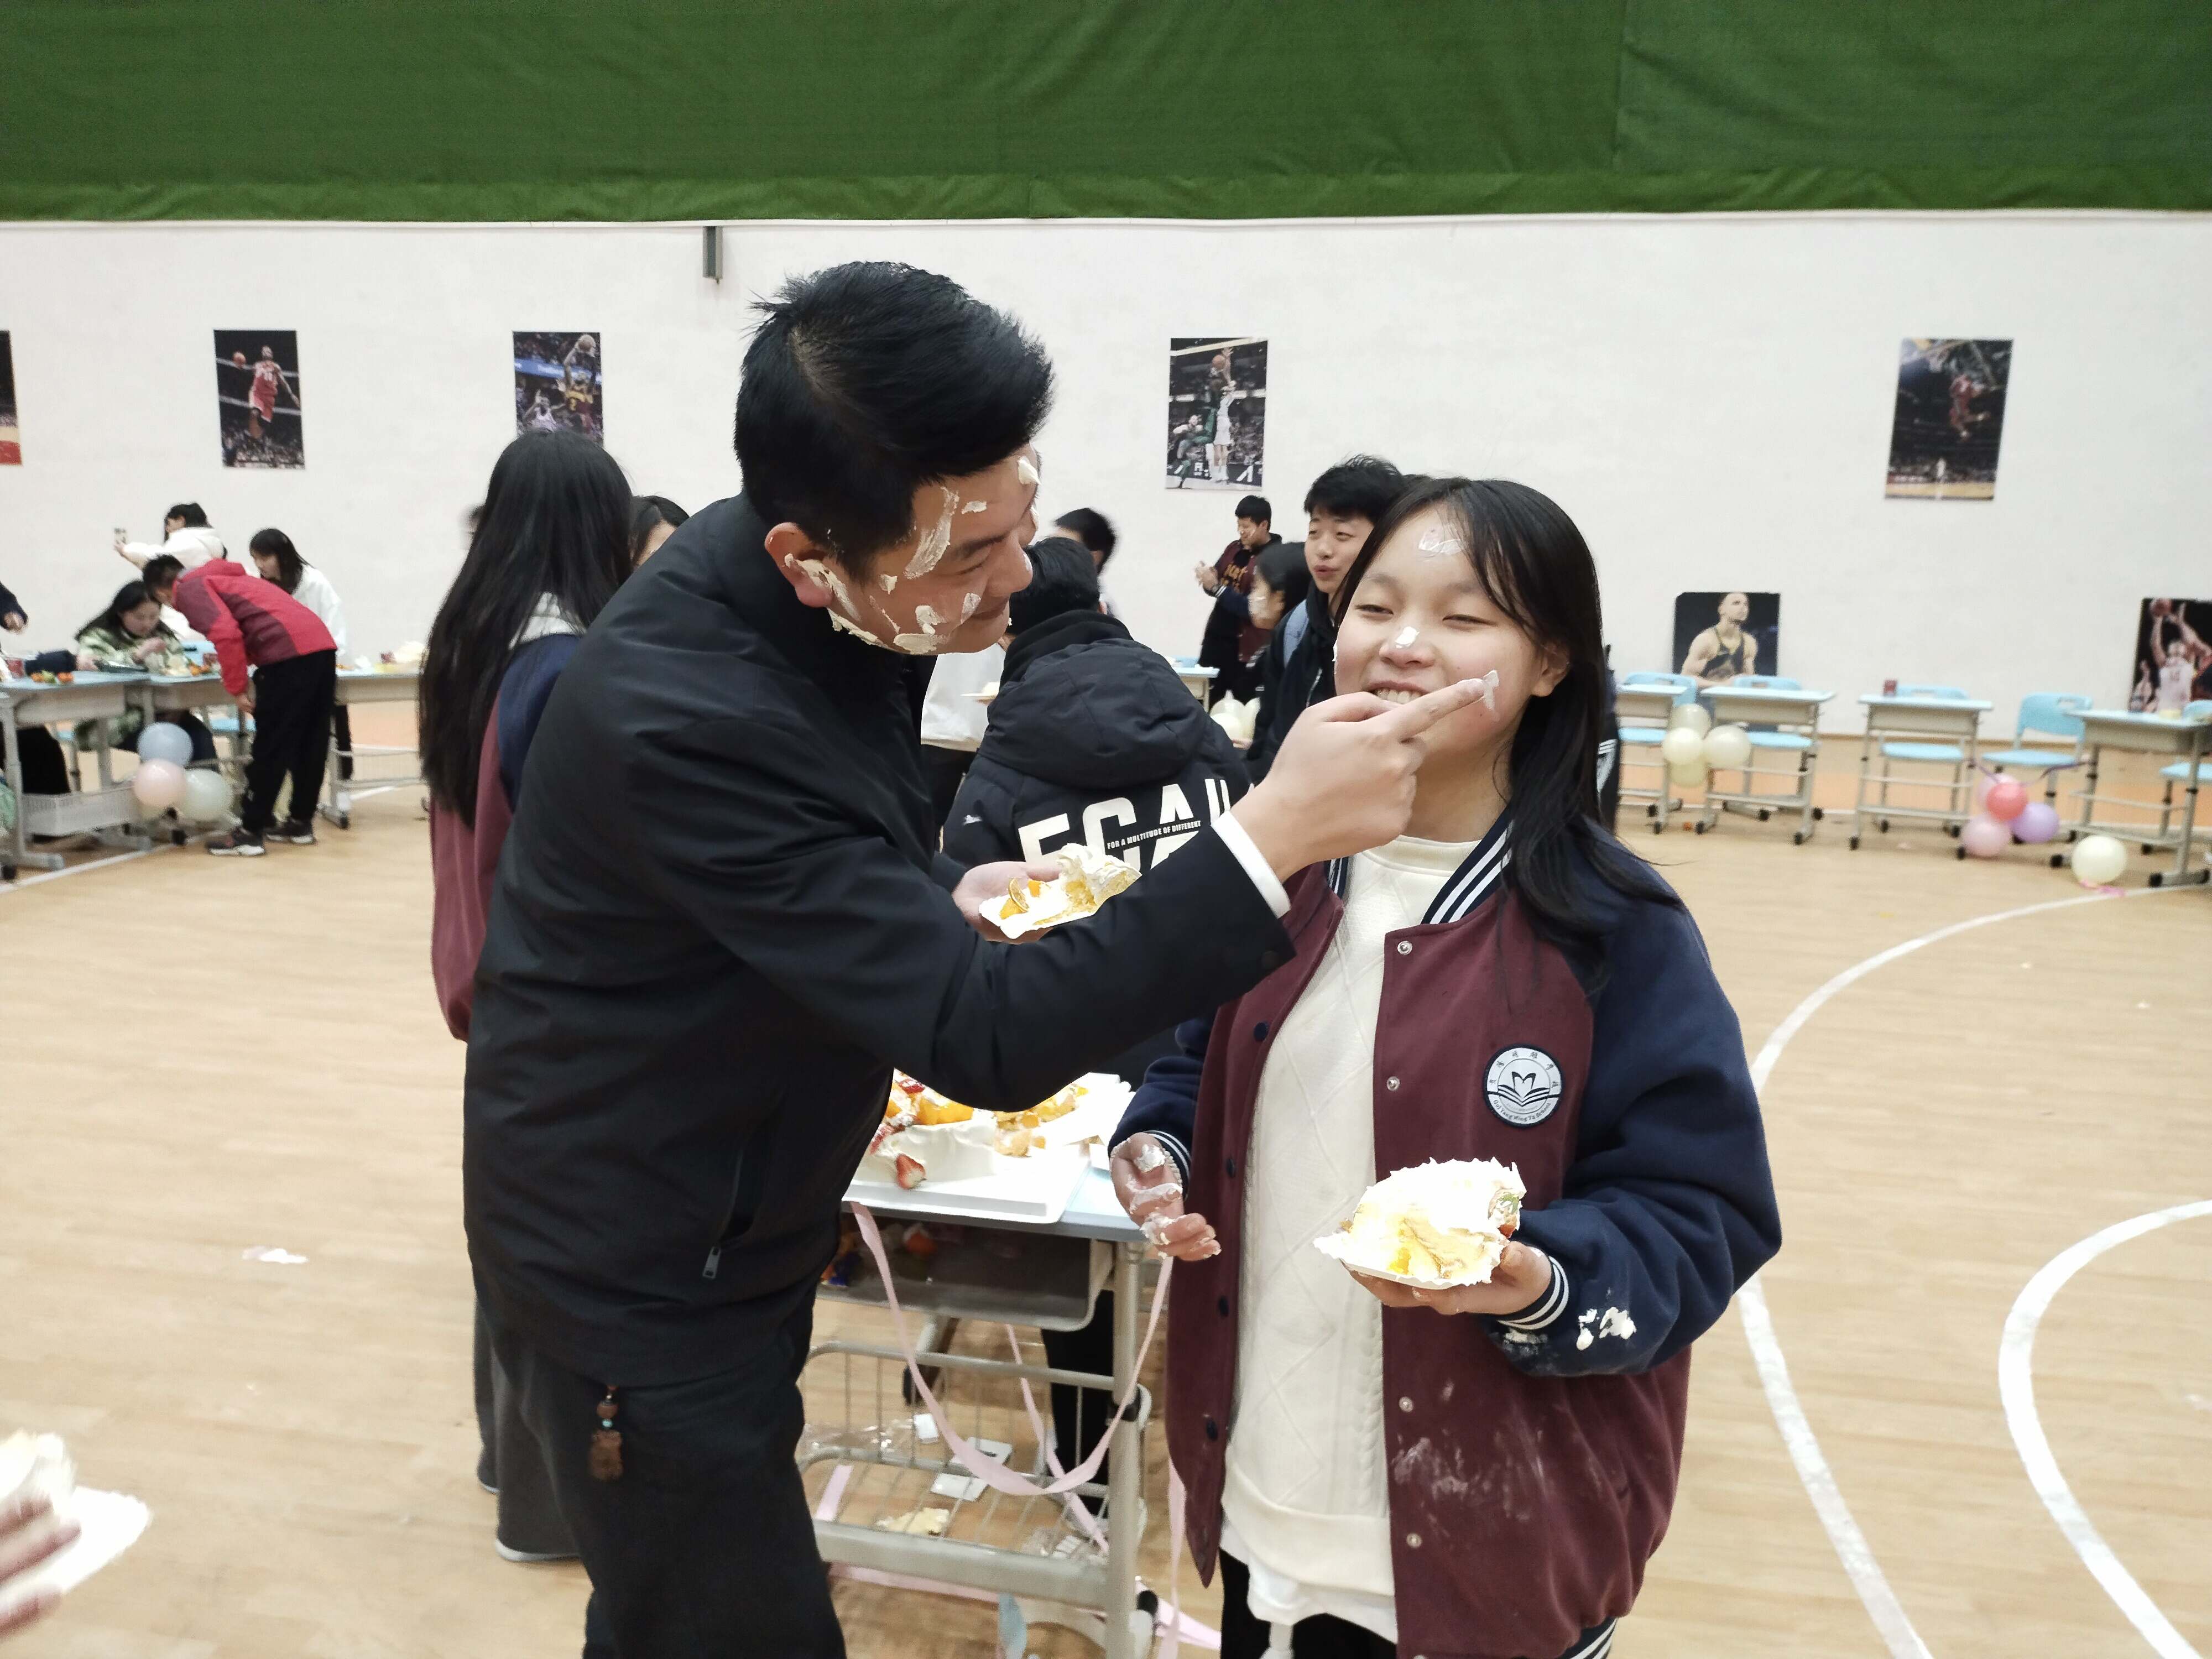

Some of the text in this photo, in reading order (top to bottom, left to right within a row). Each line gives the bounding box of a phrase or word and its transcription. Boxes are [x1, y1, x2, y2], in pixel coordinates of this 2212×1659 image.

[1107, 840, 1120, 849] FOR
[1127, 828, 1162, 844] MULTITUDE
[1163, 826, 1171, 834] OF
[1172, 820, 1201, 832] DIFFERENT
